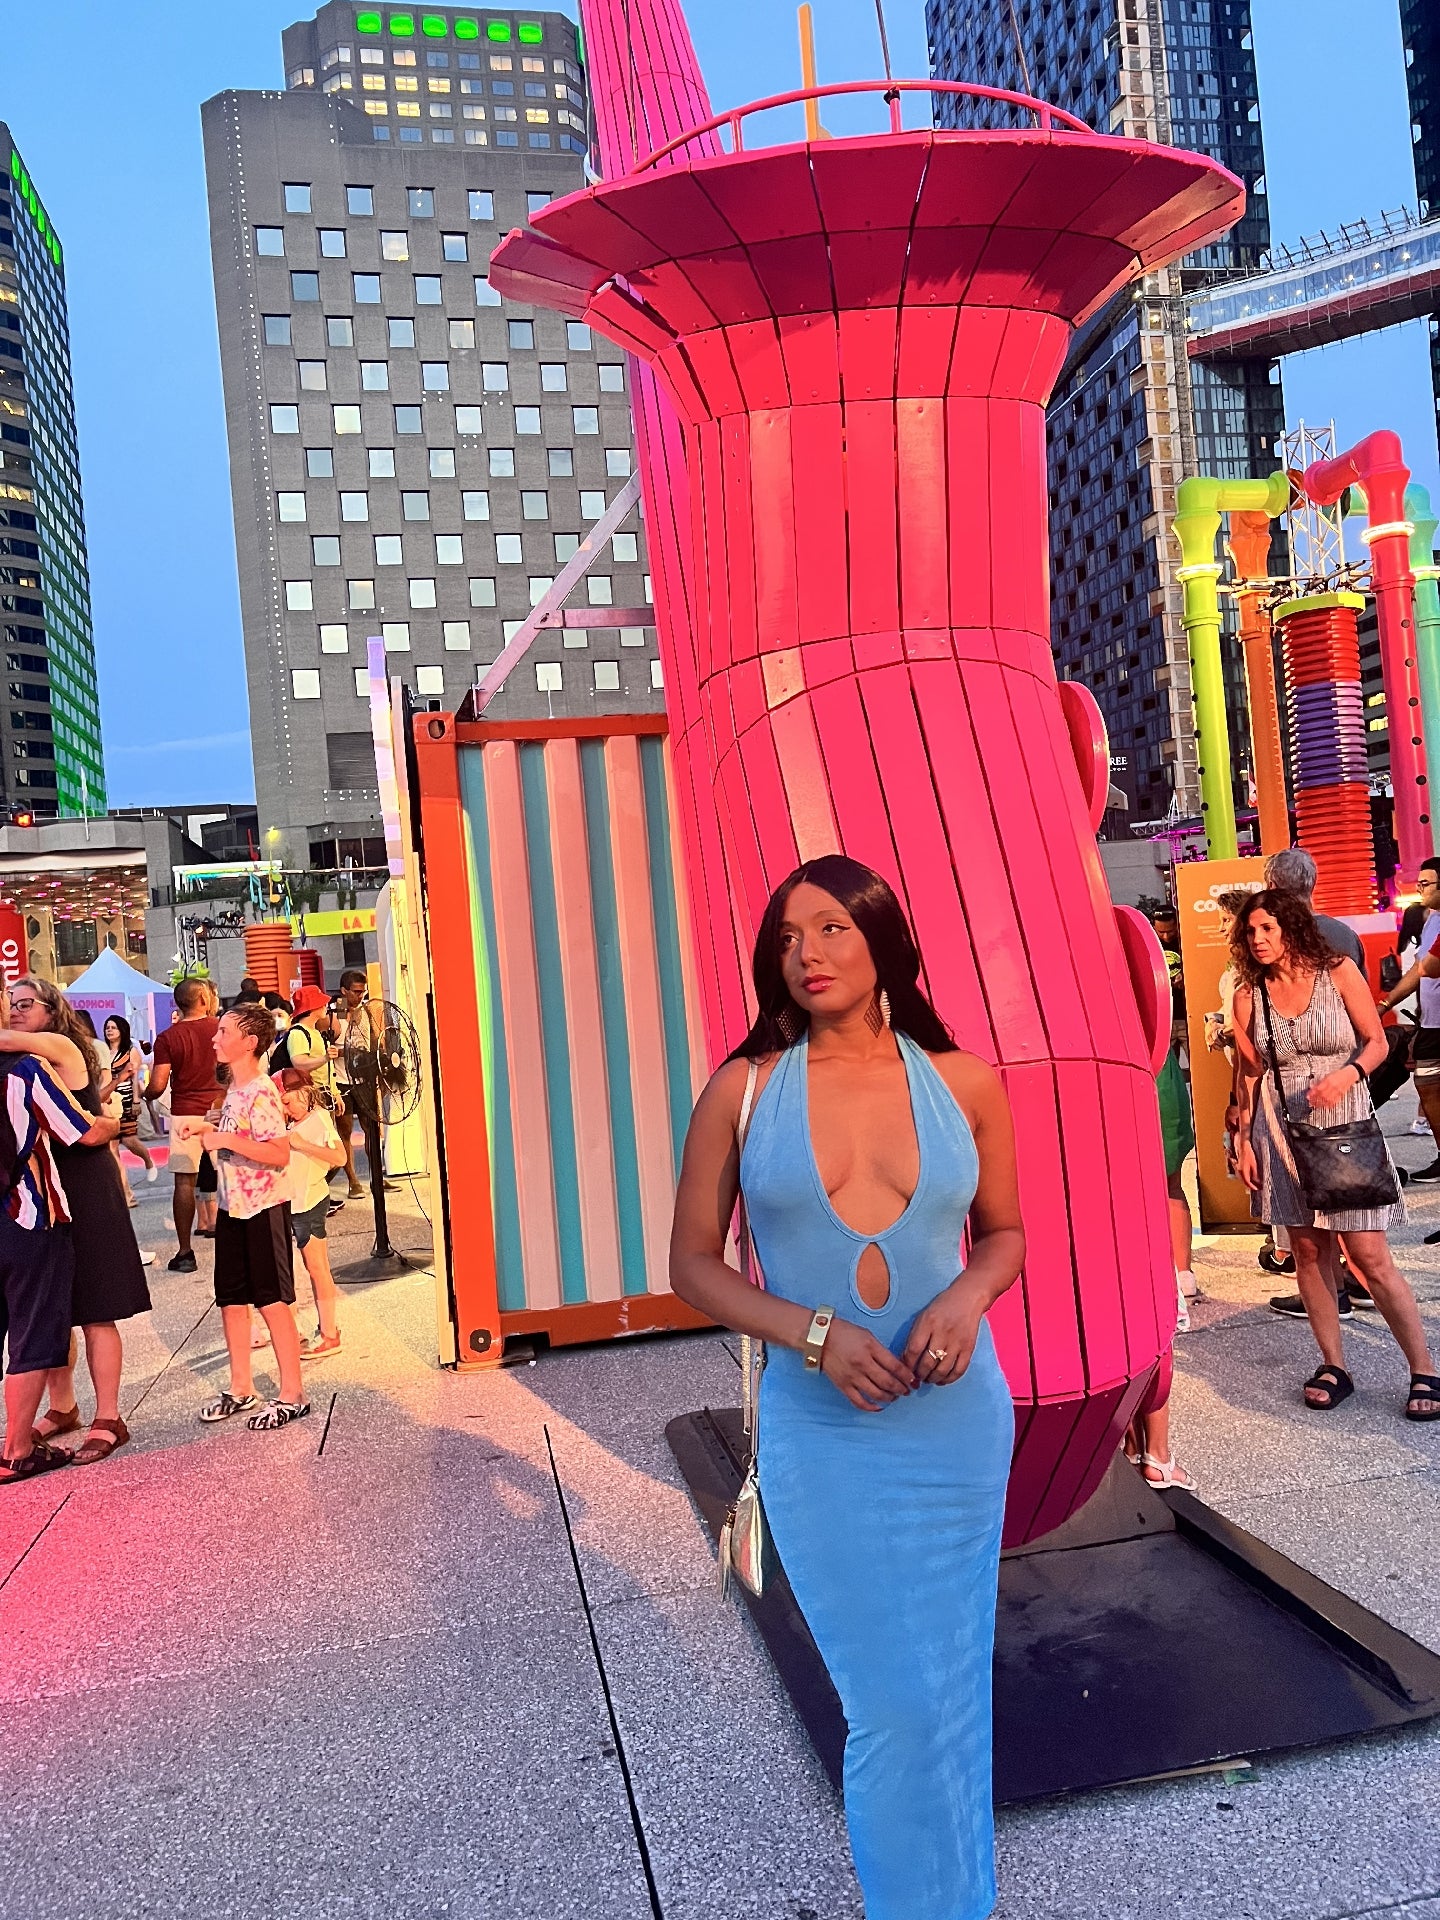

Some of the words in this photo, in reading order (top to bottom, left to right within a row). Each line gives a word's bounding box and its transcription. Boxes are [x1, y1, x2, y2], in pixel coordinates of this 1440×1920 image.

[1193, 899, 1219, 913] CO
[343, 916, 362, 930] LA
[71, 999, 116, 1009] LOPHONE
